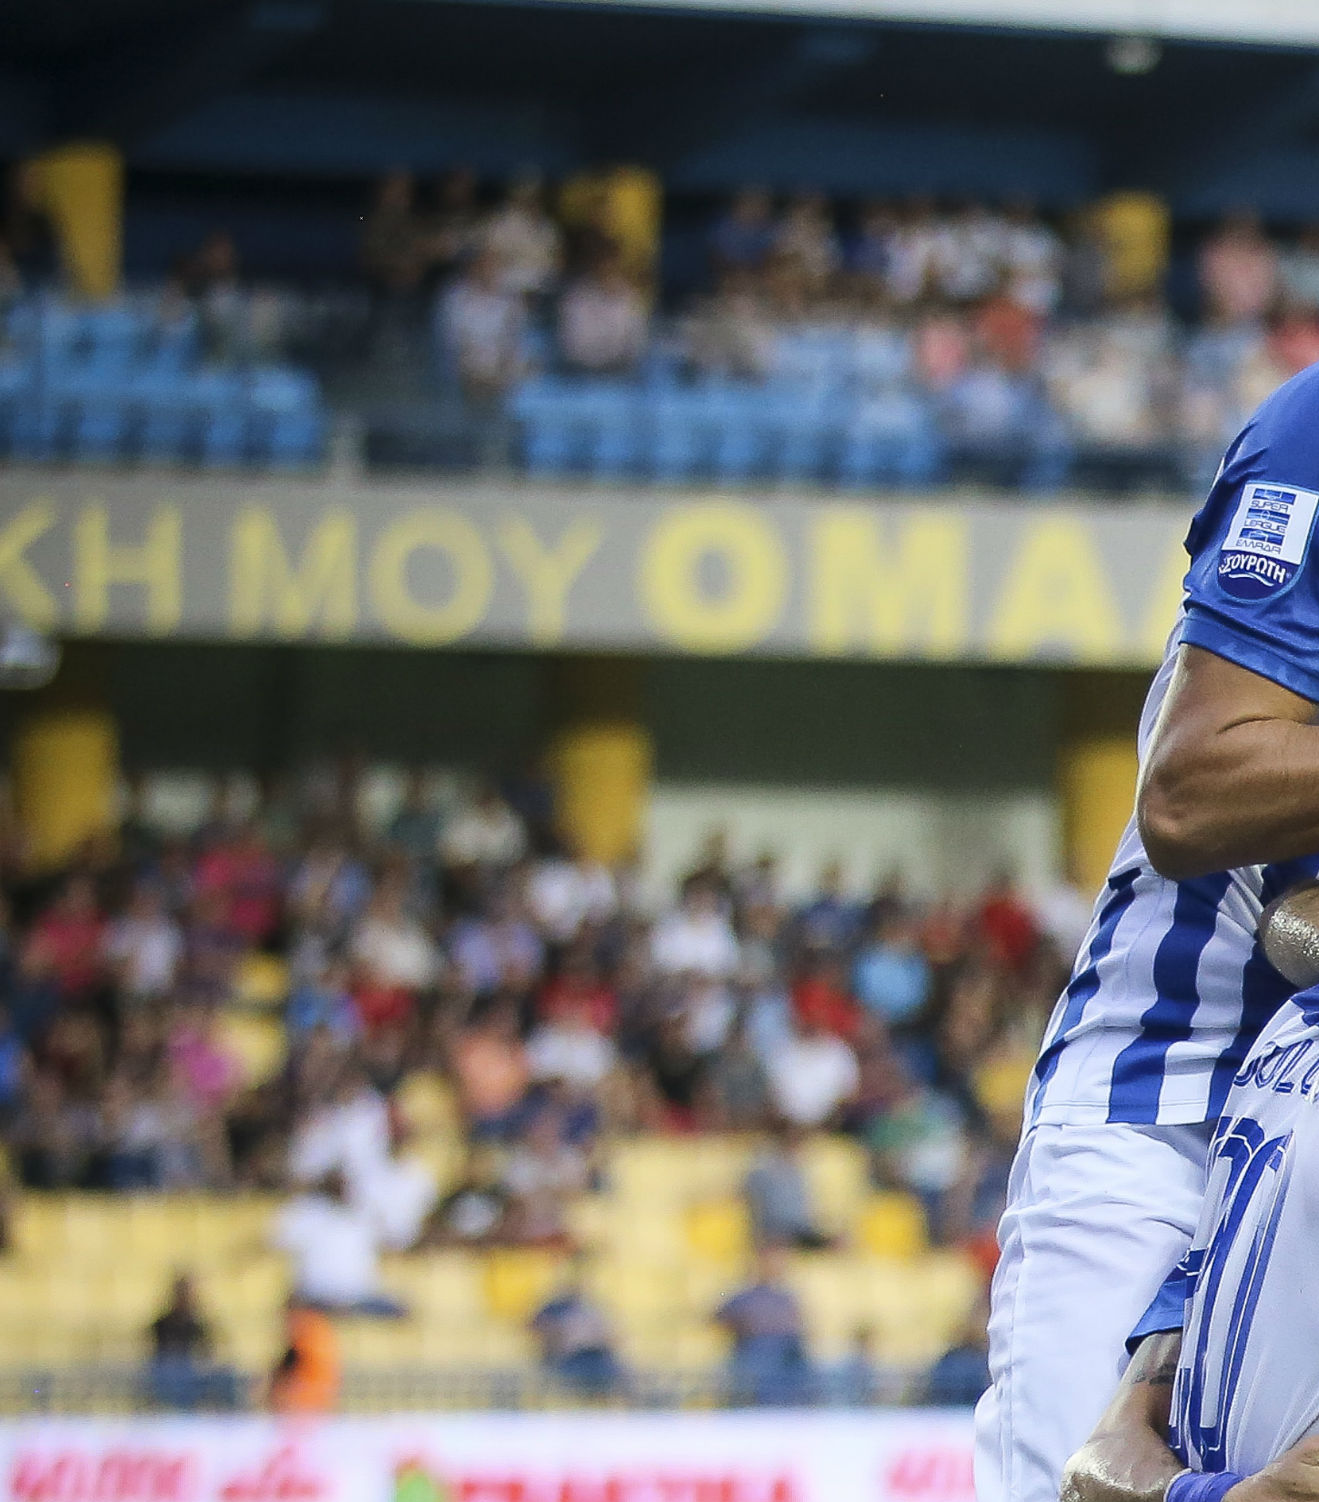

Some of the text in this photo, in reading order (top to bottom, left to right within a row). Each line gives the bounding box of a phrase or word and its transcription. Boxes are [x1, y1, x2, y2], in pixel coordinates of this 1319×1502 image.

[1250, 500, 1289, 513] SUPER
[1243, 520, 1288, 533] LEAGUE
[229, 504, 600, 650] ΜΟΥ
[1219, 554, 1287, 584] ΣΟΥΡΩΤΗ
